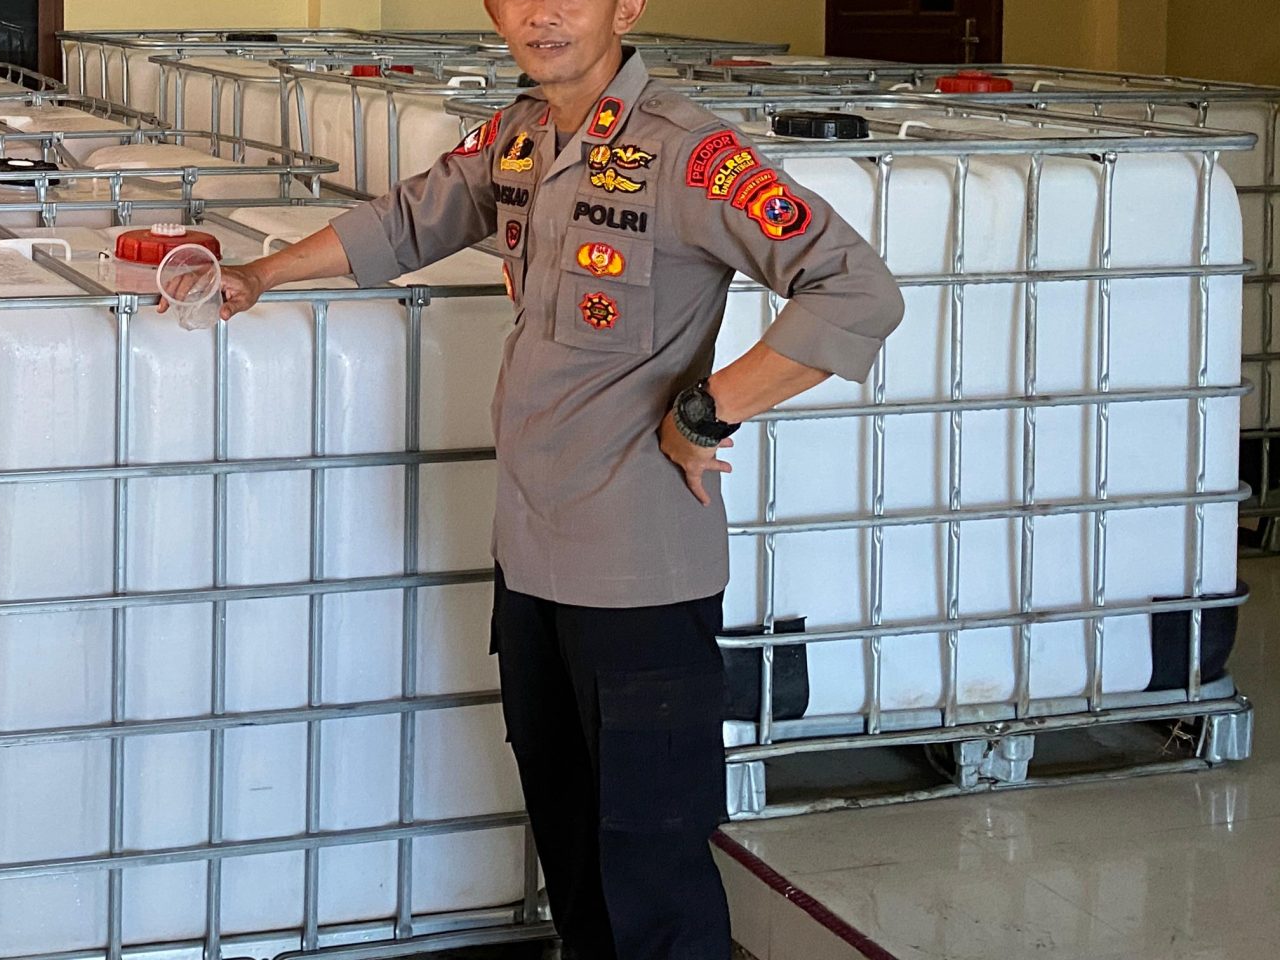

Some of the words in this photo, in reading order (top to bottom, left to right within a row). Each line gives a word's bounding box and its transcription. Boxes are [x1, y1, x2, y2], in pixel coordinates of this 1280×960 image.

[692, 136, 732, 179] PELOPOR
[711, 152, 752, 195] POLRES
[573, 201, 648, 233] POLRI
